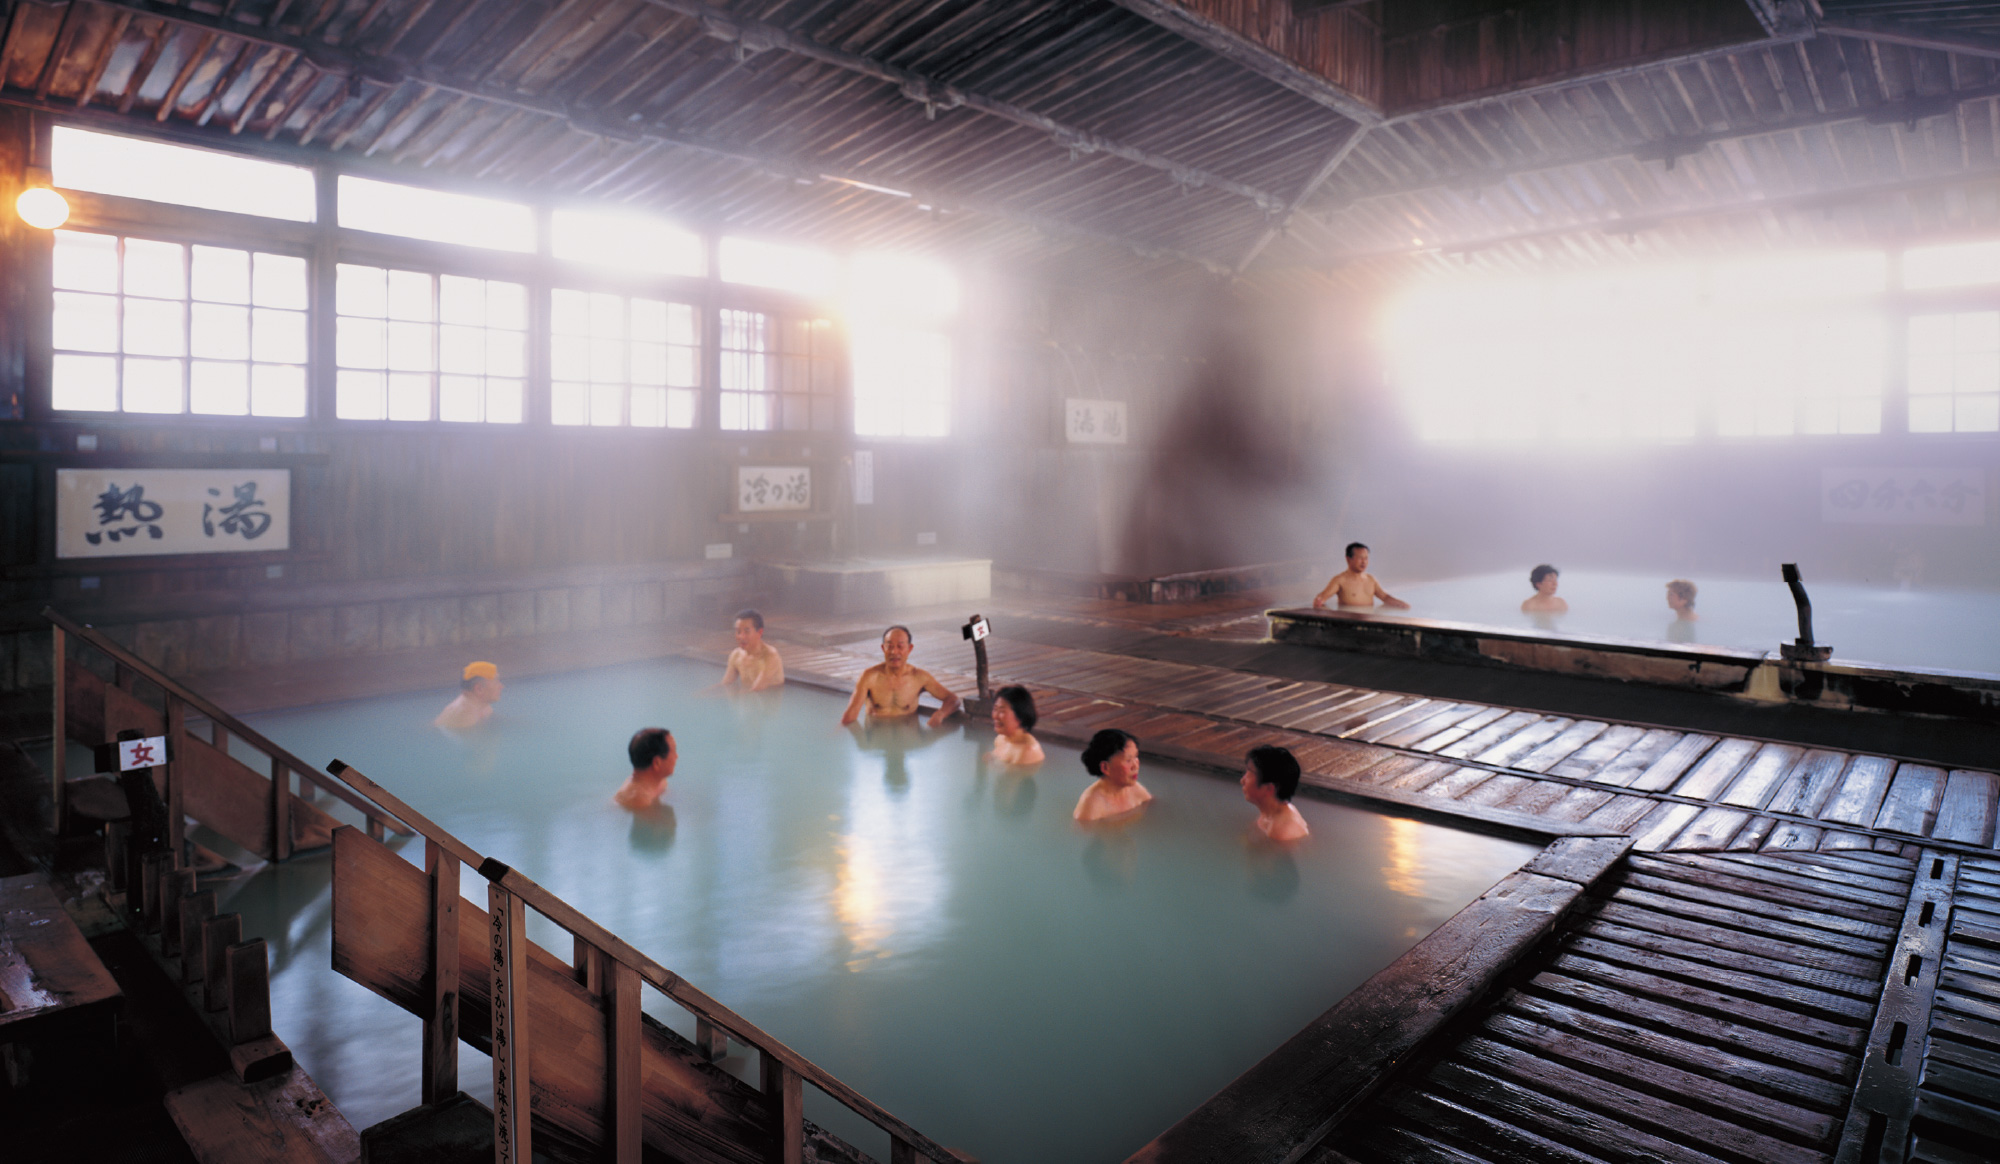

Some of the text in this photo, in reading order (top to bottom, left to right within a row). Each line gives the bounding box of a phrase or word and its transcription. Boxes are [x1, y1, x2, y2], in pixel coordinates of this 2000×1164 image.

[743, 472, 808, 505] 冷の湯
[85, 481, 272, 545] 熱湯
[130, 742, 154, 766] 女
